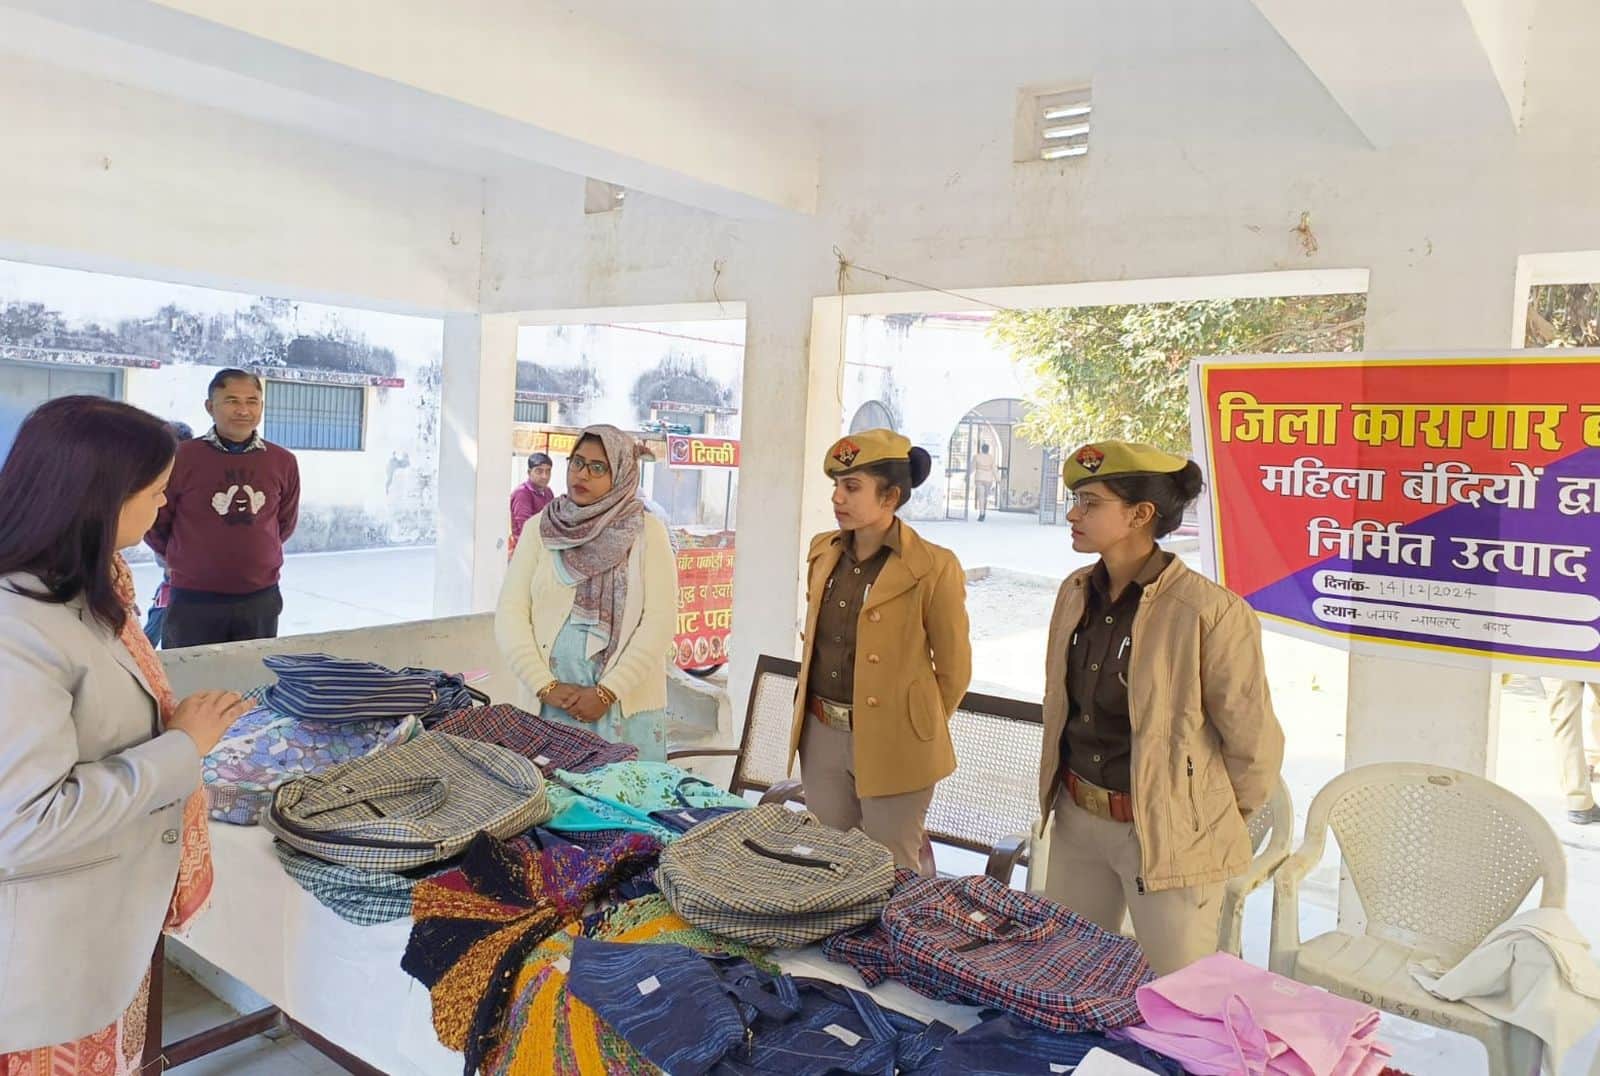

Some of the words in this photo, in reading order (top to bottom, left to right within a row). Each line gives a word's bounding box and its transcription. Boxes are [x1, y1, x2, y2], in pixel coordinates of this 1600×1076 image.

[1217, 390, 1342, 447] जिला
[1351, 402, 1568, 451] कारागार
[691, 439, 735, 465] टिक्की
[1259, 456, 1386, 501] महिला
[1400, 461, 1544, 510] बंदियों
[1306, 516, 1435, 568] निर्मित
[1450, 536, 1591, 583] उत्पाद
